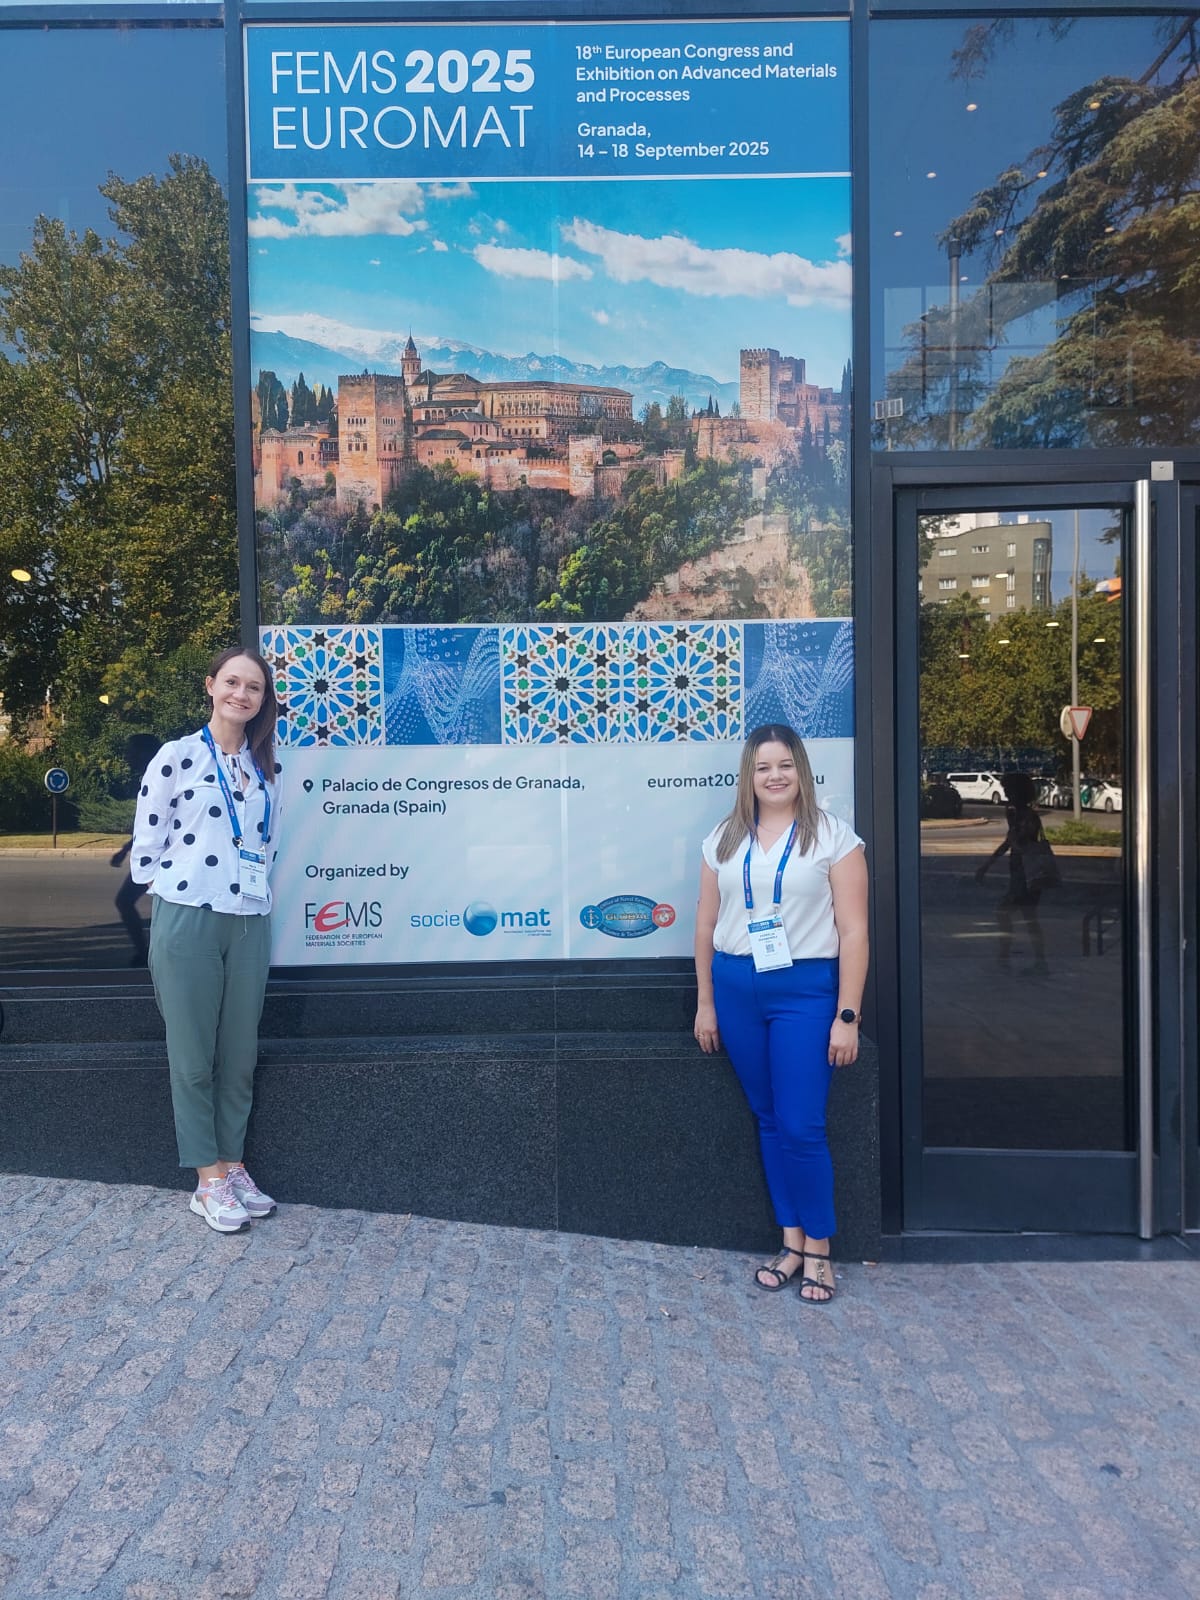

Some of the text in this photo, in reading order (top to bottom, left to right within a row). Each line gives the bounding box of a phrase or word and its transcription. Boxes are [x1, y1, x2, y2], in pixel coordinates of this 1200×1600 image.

[605, 45, 681, 62] European
[684, 43, 760, 61] Congress
[763, 43, 794, 57] and
[271, 49, 535, 94] FEMS 2025
[576, 64, 837, 81] Exhibition on Advanced Materials
[576, 88, 691, 103] and Processes
[272, 105, 534, 150] EUROMAT
[578, 122, 651, 138] Granada,
[578, 144, 595, 158] 14
[612, 143, 629, 157] 18
[635, 142, 726, 160] September
[729, 141, 769, 156] 2025
[322, 776, 585, 793] Palacio de Congresos de Granada,
[323, 800, 446, 816] Granada (Spain)
[305, 864, 409, 880] Organized by
[305, 901, 383, 932] FEMS
